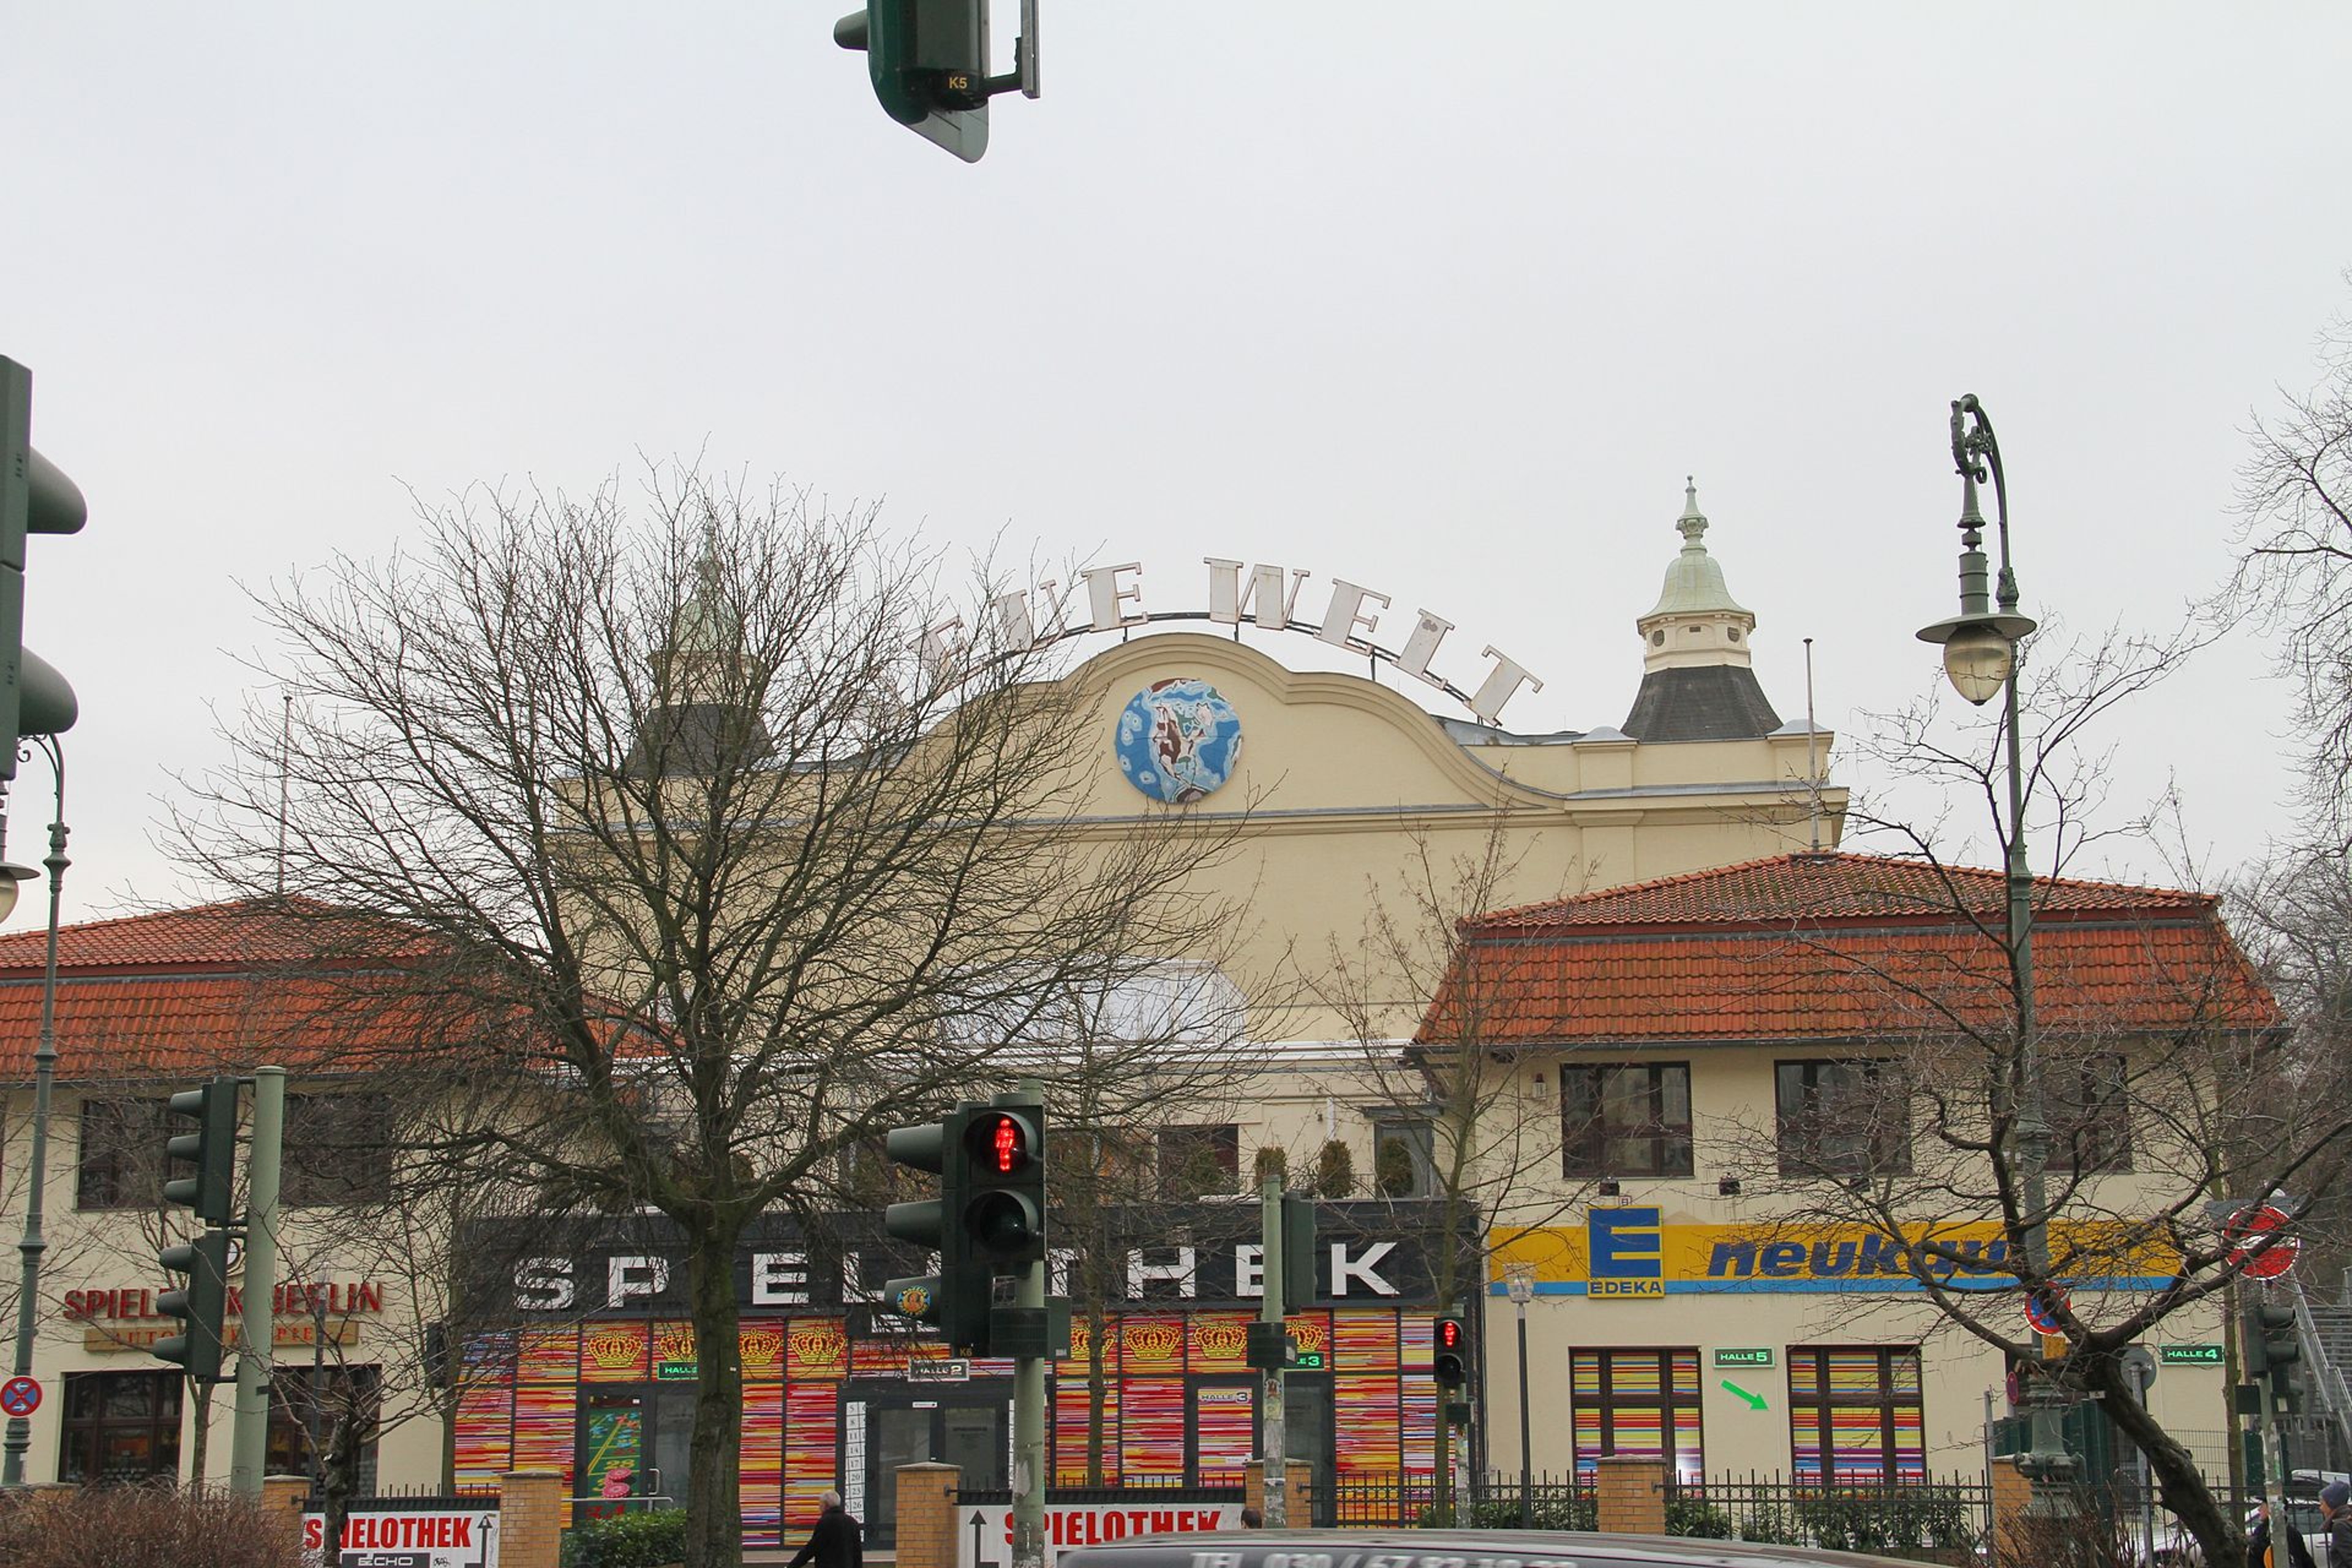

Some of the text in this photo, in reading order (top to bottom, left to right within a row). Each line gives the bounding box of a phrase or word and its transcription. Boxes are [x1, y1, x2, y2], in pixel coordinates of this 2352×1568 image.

[949, 77, 968, 89] K5
[836, 557, 1543, 742] EUE WELT
[1706, 1233, 2013, 1278] neukau
[1591, 1281, 1662, 1294] EDEKA
[960, 1349, 973, 1357] K6
[1755, 1351, 1768, 1362] 5
[2204, 1349, 2218, 1359] 4
[950, 1365, 962, 1376] 2
[1236, 1392, 1248, 1402] 3
[305, 1517, 472, 1549] SIELOTHEK
[358, 1556, 414, 1567] ECHO
